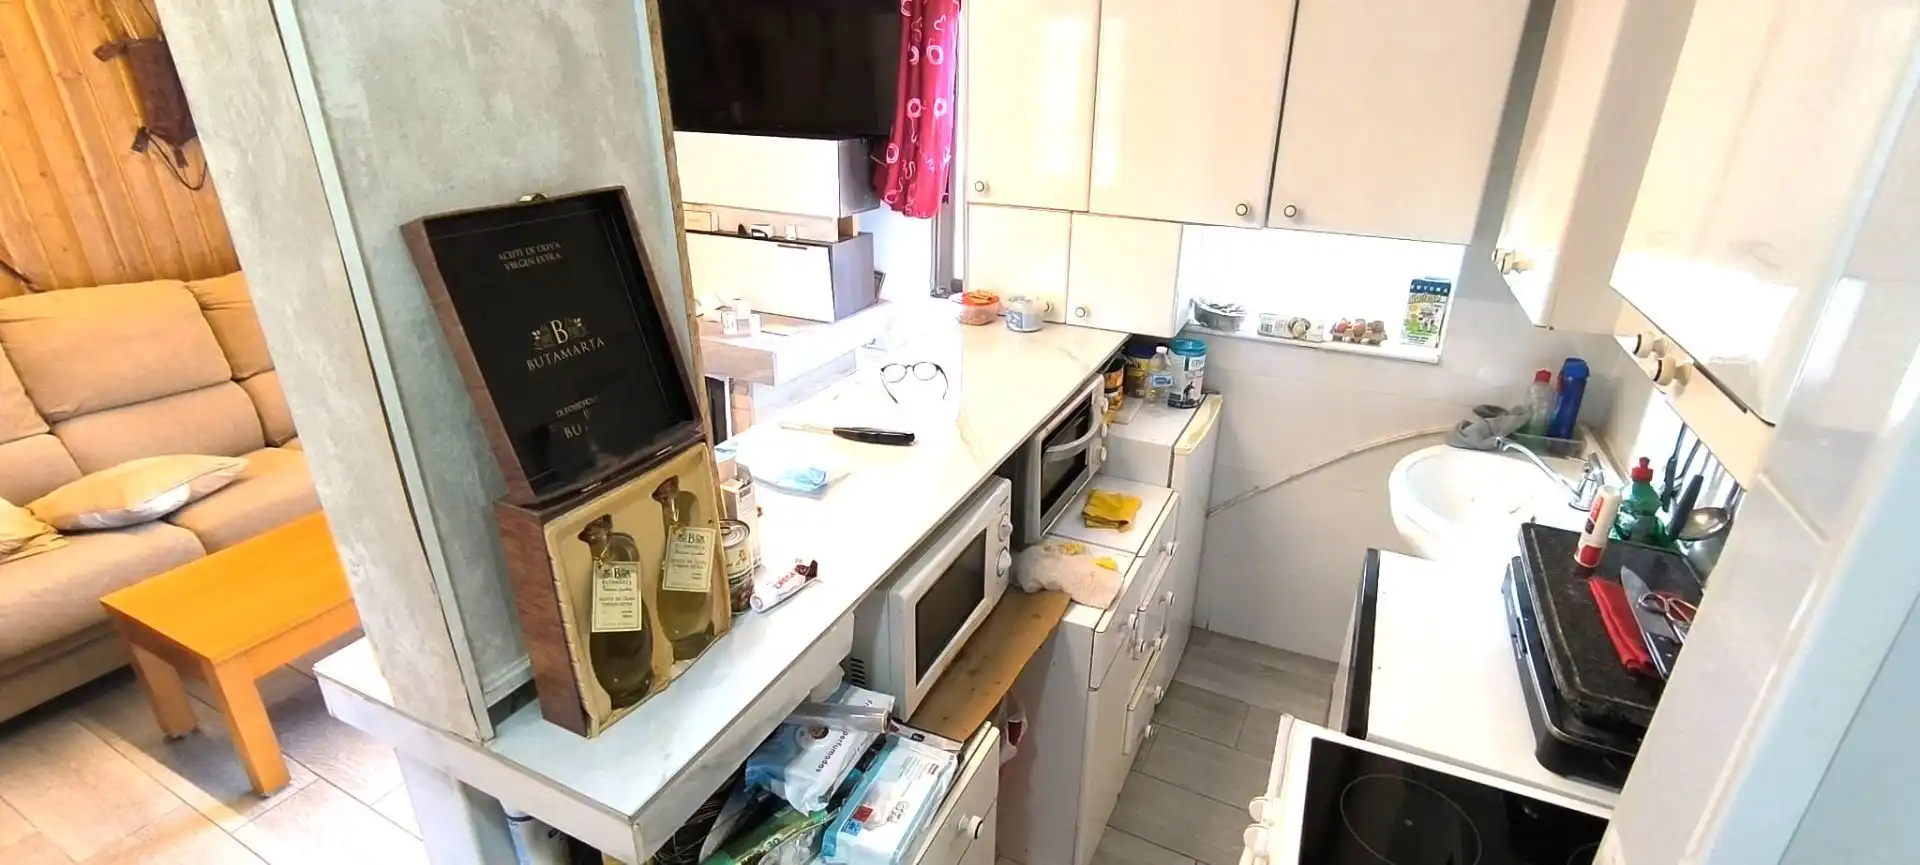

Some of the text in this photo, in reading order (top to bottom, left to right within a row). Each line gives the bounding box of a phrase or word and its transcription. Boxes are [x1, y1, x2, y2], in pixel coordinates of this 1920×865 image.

[550, 319, 569, 344] B
[526, 337, 605, 371] BUTAMARTA
[815, 730, 849, 772] perfumadas
